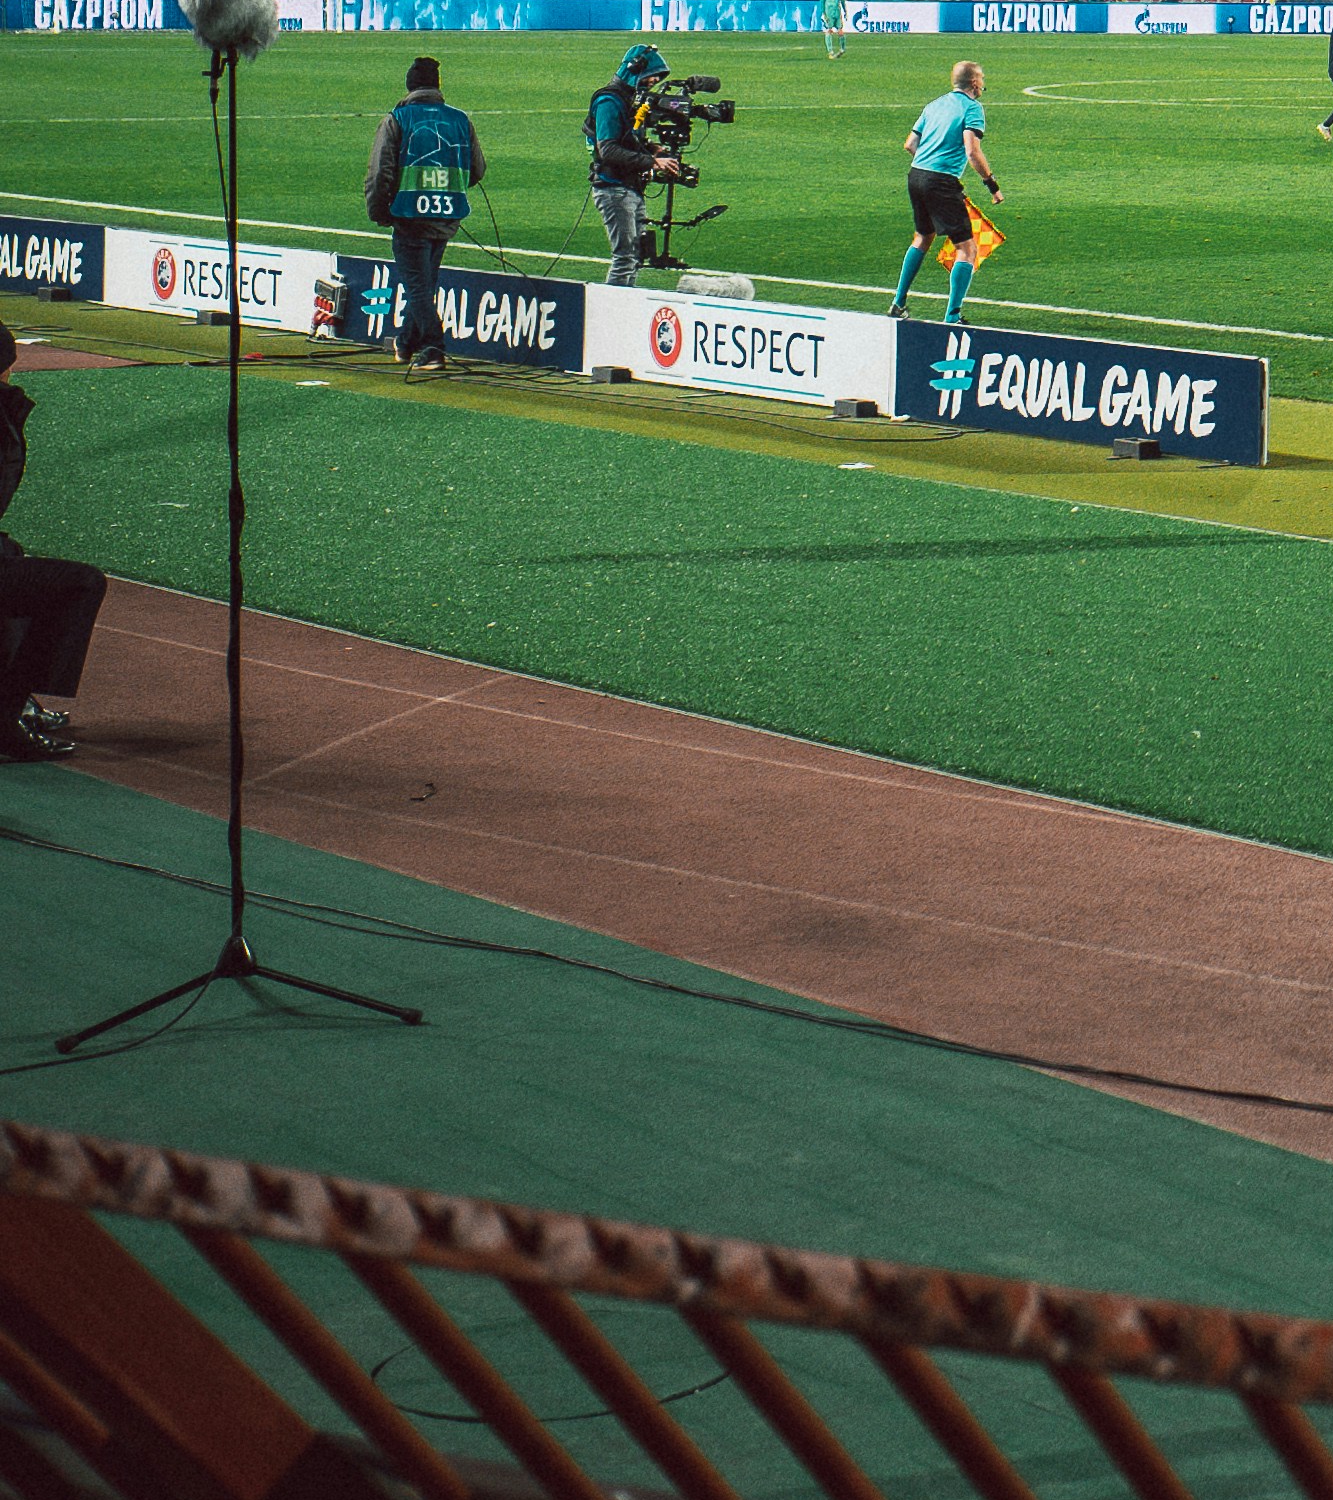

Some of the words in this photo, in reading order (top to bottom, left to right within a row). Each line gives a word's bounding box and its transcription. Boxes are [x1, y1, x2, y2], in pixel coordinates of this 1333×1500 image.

[973, 3, 1077, 33] GAZPROM
[422, 169, 450, 188] HB
[416, 195, 454, 215] 033
[654, 307, 677, 324] UEFA
[693, 320, 825, 379] RESPECT
